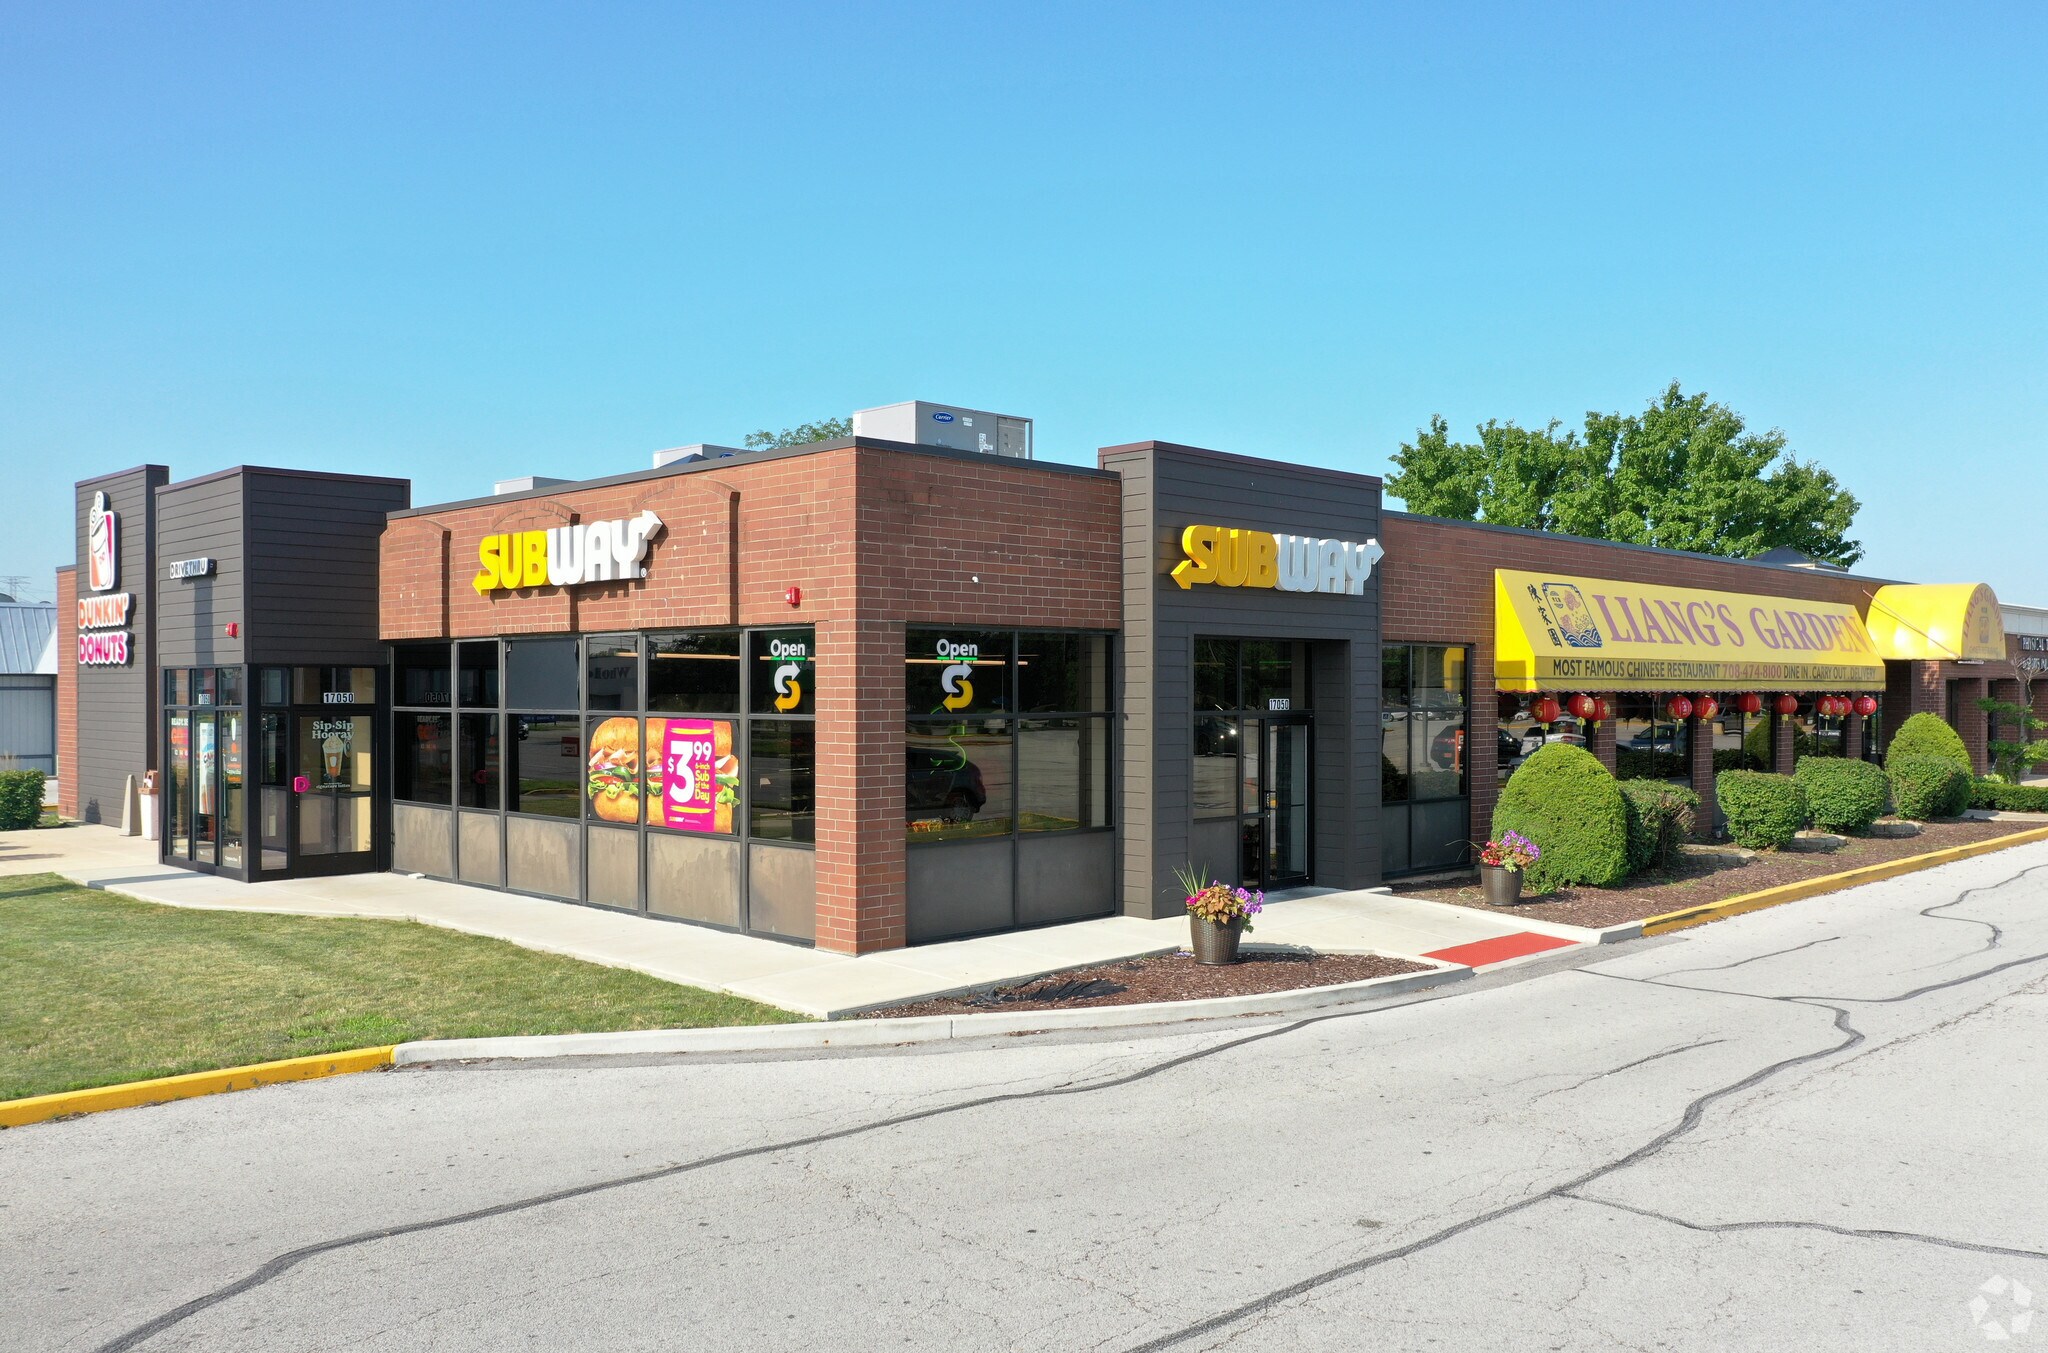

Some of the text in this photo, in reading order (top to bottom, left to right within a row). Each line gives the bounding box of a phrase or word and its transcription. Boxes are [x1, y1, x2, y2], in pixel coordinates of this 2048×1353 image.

[934, 414, 952, 422] Carrier
[472, 510, 662, 596] SUBWAY
[1170, 525, 1385, 595] SUBWAY
[79, 594, 129, 628] DUNKIN'
[1592, 595, 1870, 653] LIANG'S GARDEN
[79, 632, 127, 664] DONUTS
[770, 639, 806, 660] Open
[936, 638, 978, 660] Open
[1553, 658, 1583, 677] MOST
[1584, 659, 1625, 678] FAMOUS
[1626, 661, 1665, 678] CHINESE
[1667, 662, 1720, 679] RESTAURANT
[1783, 665, 1800, 680] DINE
[1811, 666, 1832, 680] CARRY
[1833, 667, 1847, 680] OUT
[1850, 667, 1876, 681] DELIVERY
[325, 693, 354, 703] 17050
[1269, 699, 1289, 710] 17050
[311, 730, 355, 741] Hooray
[694, 770, 710, 781] Sub
[694, 789, 710, 804] Day
